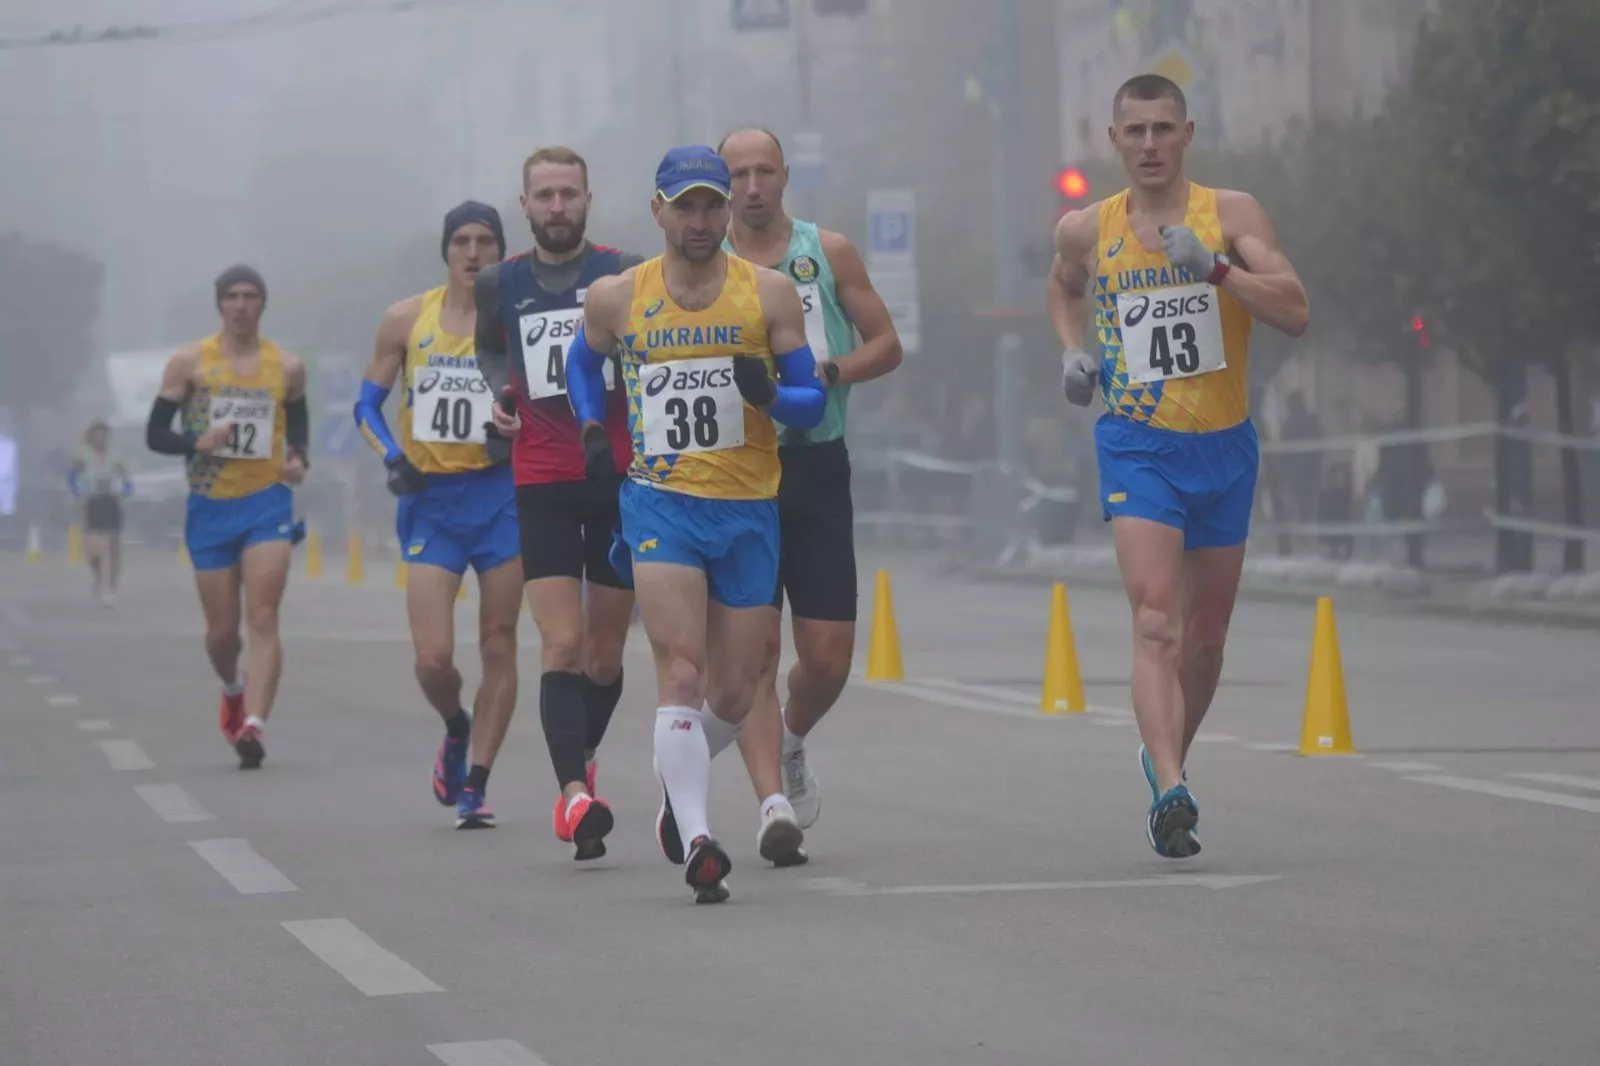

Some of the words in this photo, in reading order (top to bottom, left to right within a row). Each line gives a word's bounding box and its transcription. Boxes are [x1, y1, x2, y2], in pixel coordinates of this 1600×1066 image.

[1118, 266, 1195, 290] UKRAIN
[1152, 294, 1209, 319] asics
[647, 325, 743, 348] UKRAINE
[1149, 322, 1200, 376] 43
[428, 355, 477, 368] UKRAIN
[547, 344, 567, 390] 4
[440, 376, 488, 393] asics
[672, 368, 731, 390] asics
[431, 398, 472, 440] 40
[665, 395, 719, 450] 38
